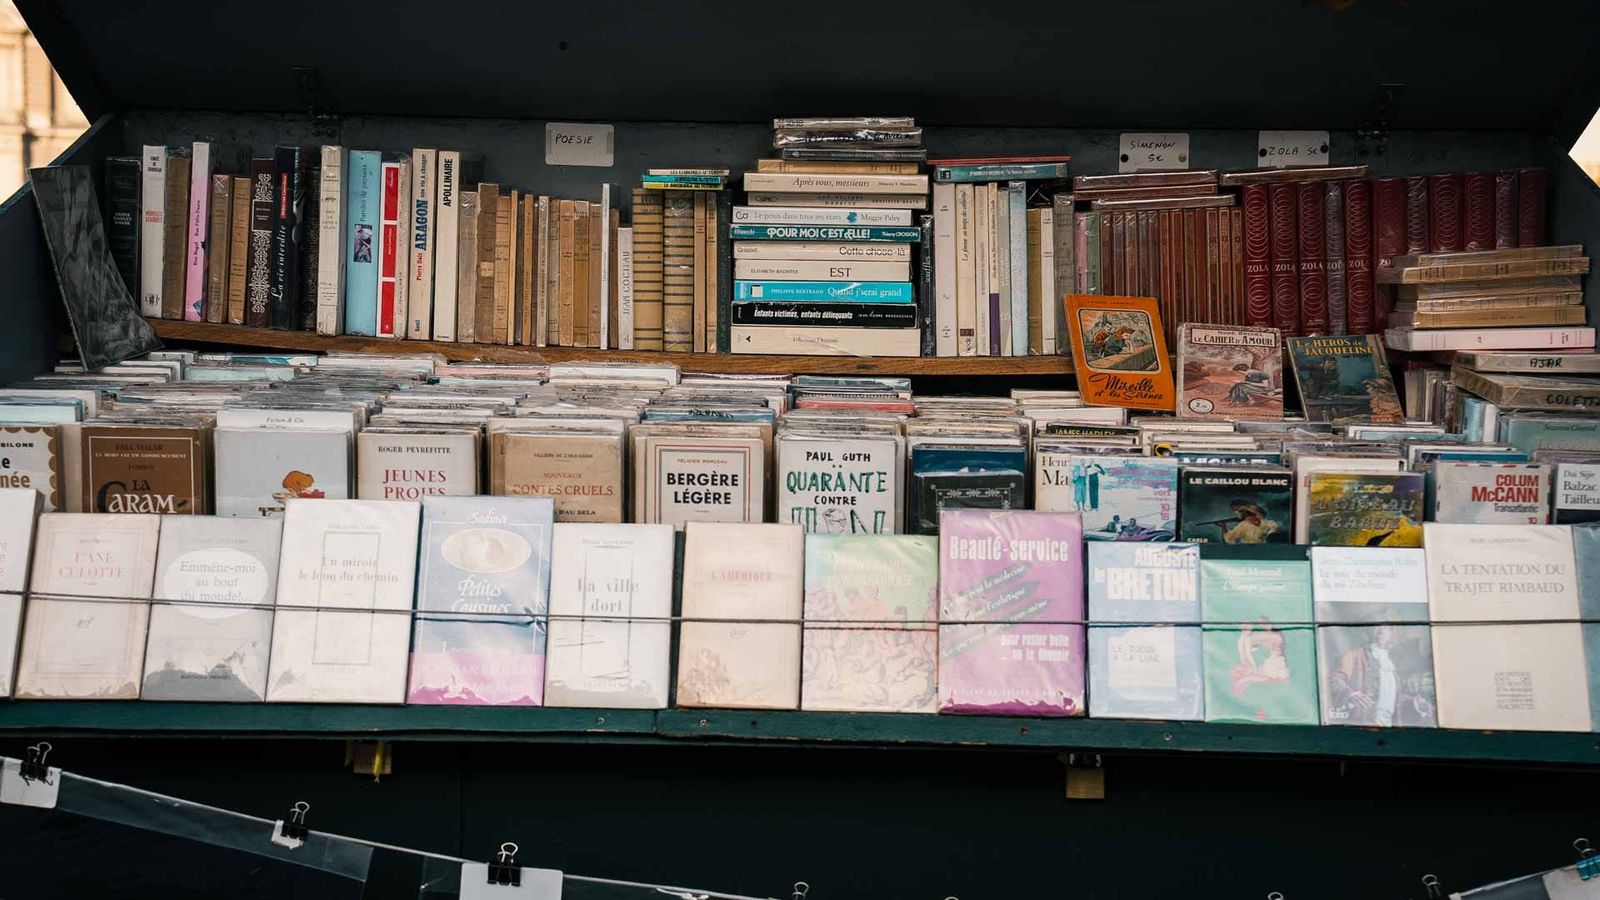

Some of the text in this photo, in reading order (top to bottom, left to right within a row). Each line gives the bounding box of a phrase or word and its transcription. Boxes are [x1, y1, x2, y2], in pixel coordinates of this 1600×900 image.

[554, 133, 594, 145] POESIE
[1130, 140, 1176, 149] SIMENON
[1268, 147, 1298, 155] ZOLA
[443, 158, 453, 206] APOLLINAIRE
[792, 177, 870, 188] Après vous, messieurs
[415, 199, 428, 251] ARAGON
[767, 227, 798, 239] POUR
[800, 228, 819, 238] MOI
[276, 225, 286, 265] interdite
[839, 246, 863, 256] Cette
[622, 250, 630, 293] COCTEAU
[830, 268, 852, 278] EST
[828, 287, 854, 297] Quand
[880, 287, 902, 298] grand
[754, 309, 854, 320] Enfants victimes, enfants délinquants
[1204, 335, 1234, 343] CAHIER
[1312, 338, 1351, 347] HEROS
[1305, 346, 1374, 355] JACQUELINE
[1530, 357, 1562, 368] AJAR
[1088, 373, 1155, 392] Mireille
[1094, 389, 1104, 397] et
[406, 446, 452, 454] PEYREFITTE
[806, 451, 871, 462] PAUL GUTH
[383, 469, 447, 484] JEUNES
[667, 471, 739, 487] BERGÈRE
[787, 470, 887, 495] QUARANTE
[1252, 478, 1288, 486] BLANC
[1496, 474, 1539, 487] COLUM
[132, 480, 150, 490] LA
[512, 484, 614, 496] CONTES CRUELS
[1563, 480, 1597, 492] Balzac
[674, 488, 731, 505] LÉGÈRE
[814, 495, 857, 505] CONTRE
[1472, 486, 1539, 503] McCANN
[1494, 502, 1539, 513] Transatlantic
[180, 560, 257, 574] Emmène-moi
[1441, 564, 1566, 576] LA TENTATION DU
[195, 576, 239, 587] au bout
[458, 575, 502, 598] Petites
[607, 577, 639, 593] ville
[1106, 567, 1197, 601] BRETON
[1444, 582, 1564, 596] TRAJET RIMBAUD
[181, 590, 195, 601] du
[591, 598, 623, 612] dort
